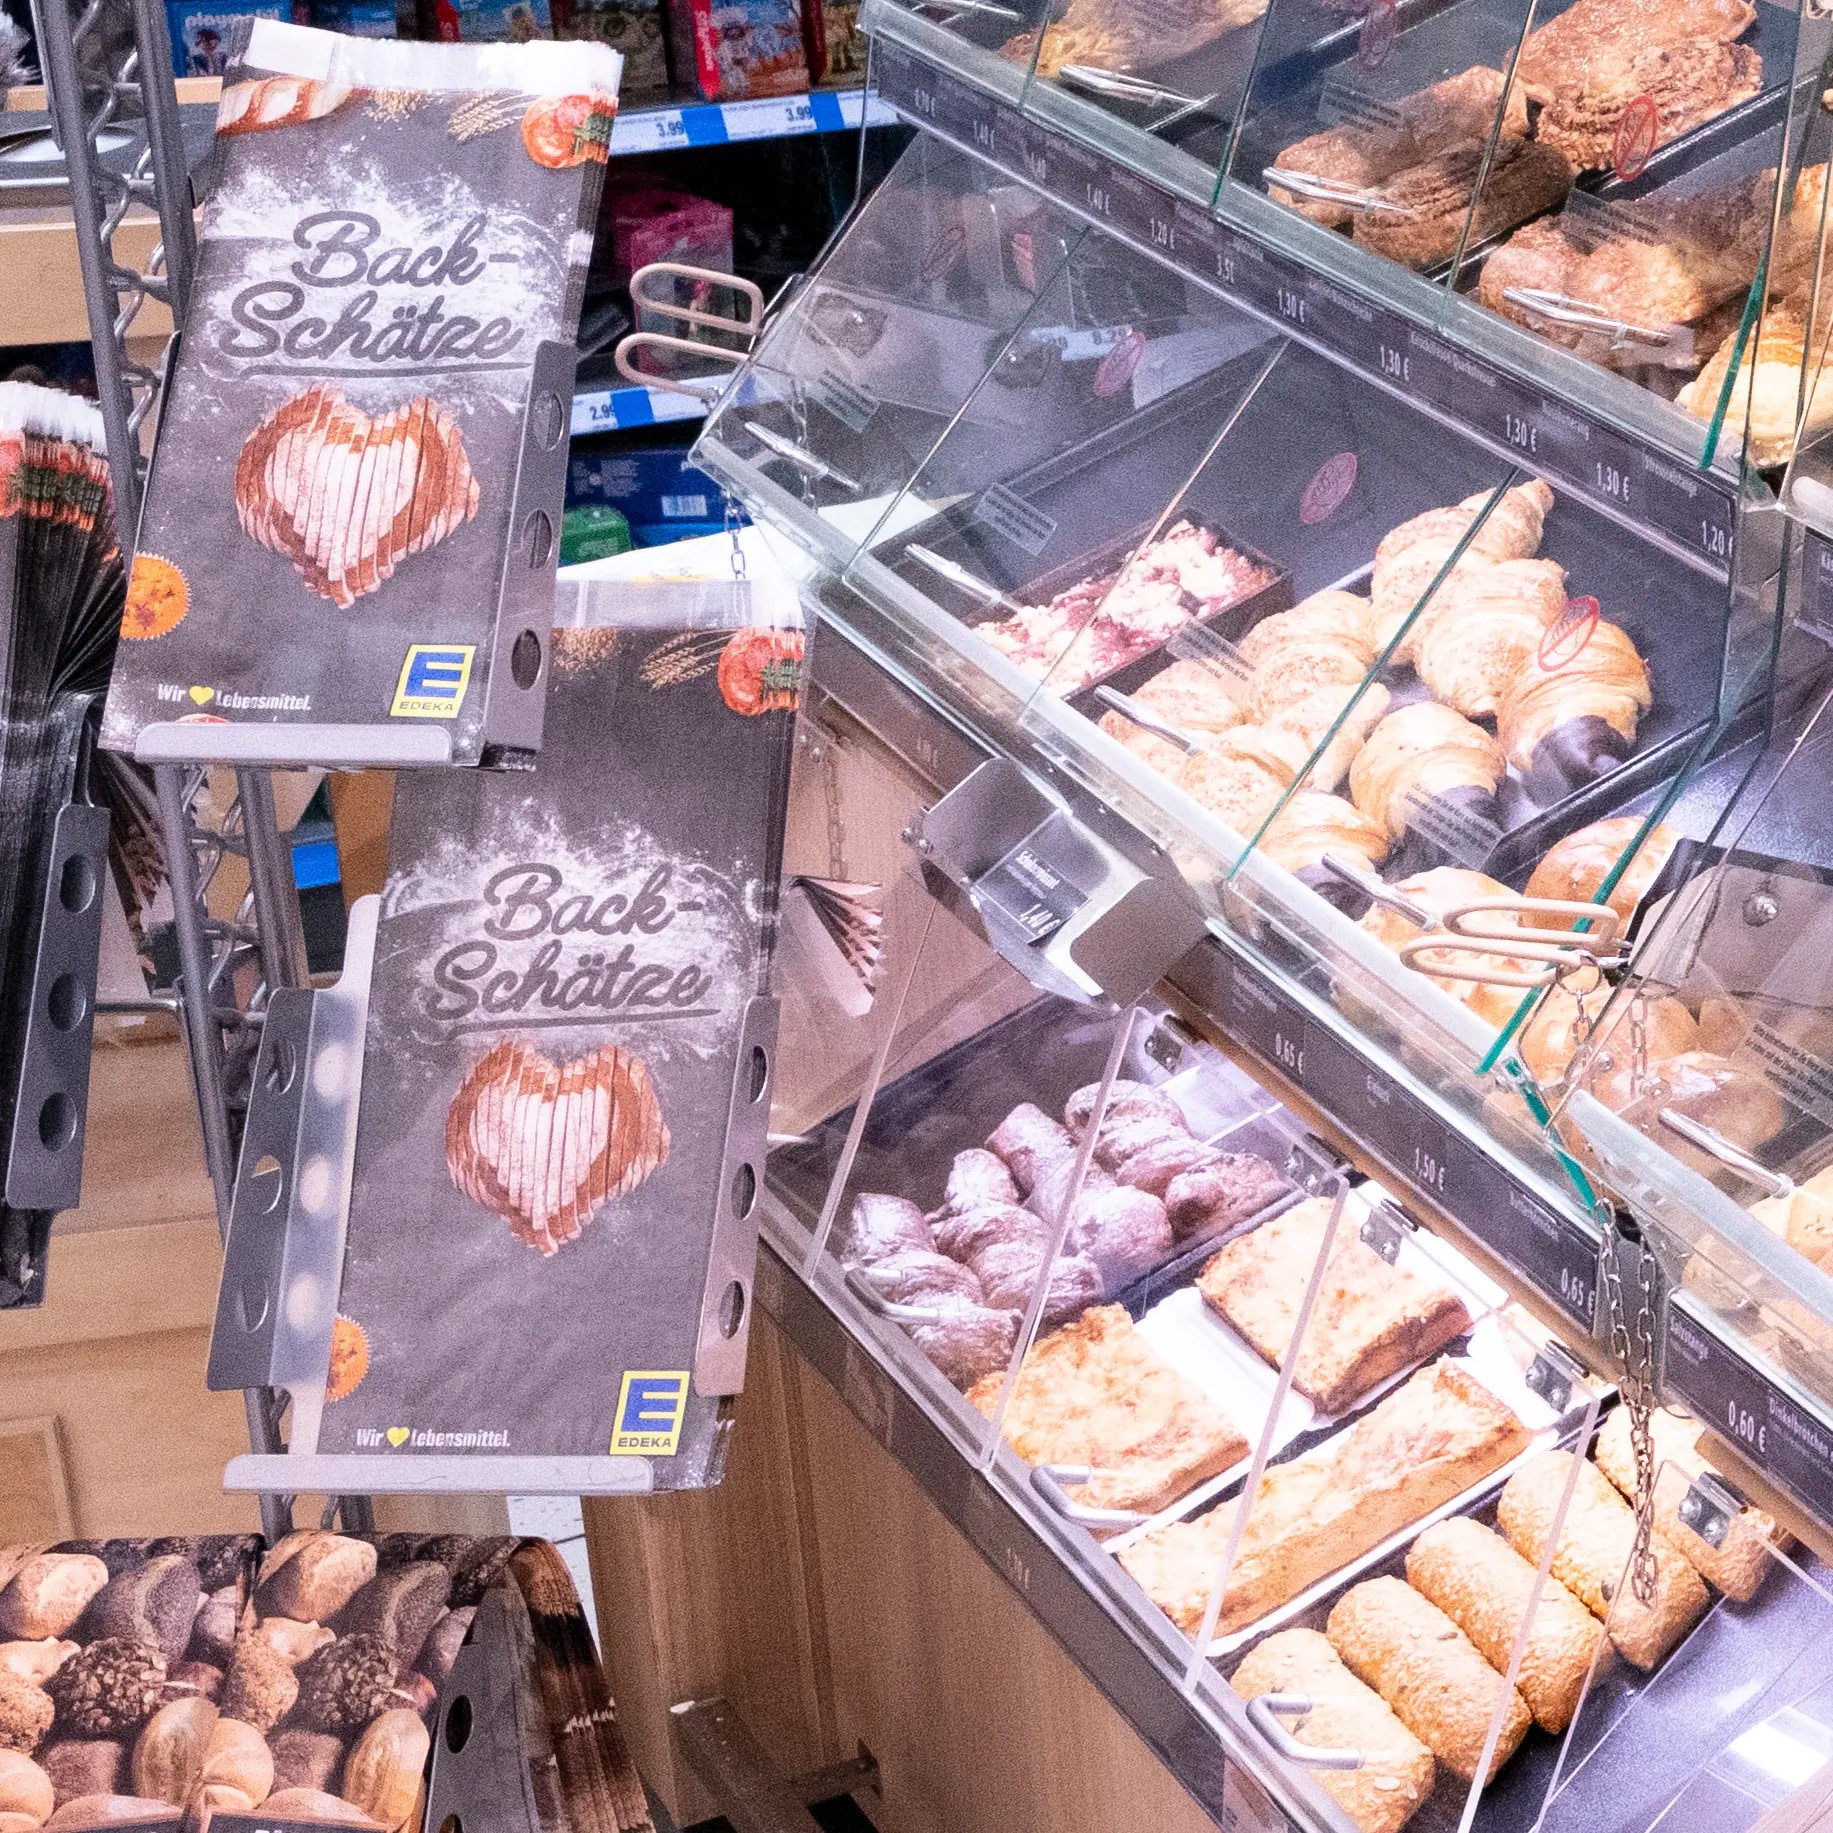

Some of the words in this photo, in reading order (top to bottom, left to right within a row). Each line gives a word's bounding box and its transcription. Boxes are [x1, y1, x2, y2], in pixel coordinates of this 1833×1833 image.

[656, 120, 685, 138] 3.99
[785, 105, 813, 122] 3.99
[291, 209, 520, 289] Back-
[218, 280, 525, 364] Schätze
[1278, 288, 1298, 319] 1,30
[1299, 299, 1306, 323] €
[1380, 345, 1402, 377] 1,30
[1403, 357, 1410, 382] €
[1505, 413, 1529, 448] 1,30
[1530, 426, 1538, 453] €
[1596, 461, 1620, 496] 1,30
[1622, 475, 1630, 503] €
[1702, 520, 1725, 556] 1,20
[156, 683, 187, 703] Wir
[215, 689, 312, 712] Lebensmittel.
[399, 700, 455, 712] EDEKA
[484, 862, 703, 942] Back-
[1037, 918, 1061, 936] €
[425, 939, 715, 1022] Schätze
[1275, 1032, 1296, 1069] 0,65
[1297, 1050, 1305, 1076] €
[1413, 1146, 1436, 1186] 1,50
[1437, 1165, 1445, 1193] €
[1560, 1268, 1585, 1307] 0,65
[1587, 1290, 1596, 1316] €
[356, 1428, 385, 1447] Wir
[410, 1428, 511, 1448] Lebensmittel.
[617, 1437, 672, 1449] EDEKA
[1728, 1400, 1755, 1443] 0,60
[1758, 1425, 1767, 1454] €
